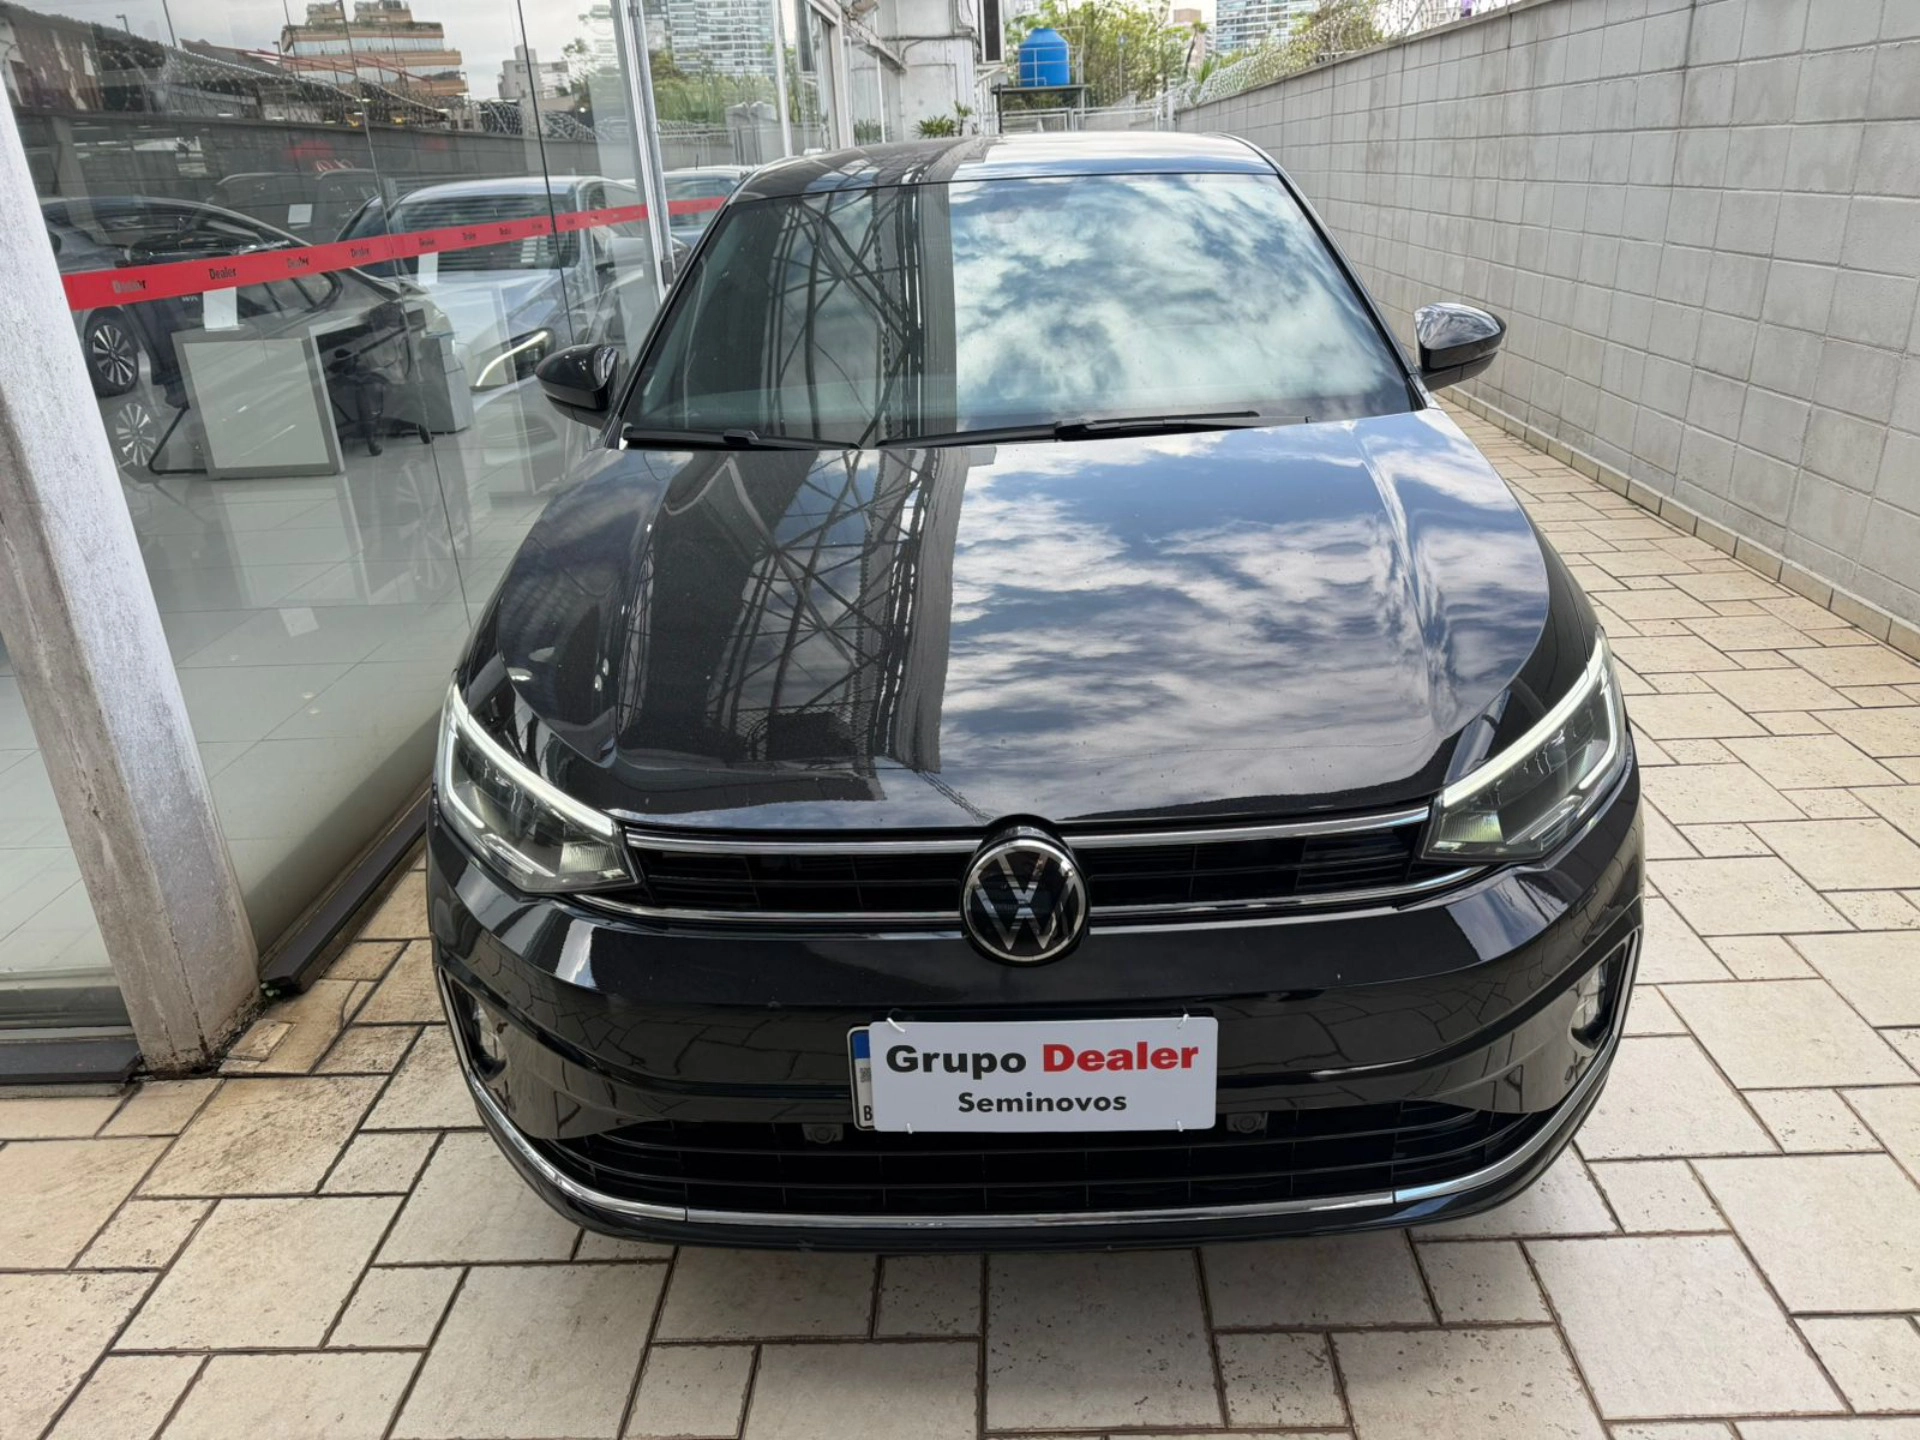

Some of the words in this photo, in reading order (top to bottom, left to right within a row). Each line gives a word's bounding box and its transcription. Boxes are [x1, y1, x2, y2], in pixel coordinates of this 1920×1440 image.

[209, 267, 236, 279] Dealer
[886, 1044, 1027, 1080] Grupo
[1042, 1041, 1199, 1072] Dealer
[958, 1091, 1127, 1113] Seminovos
